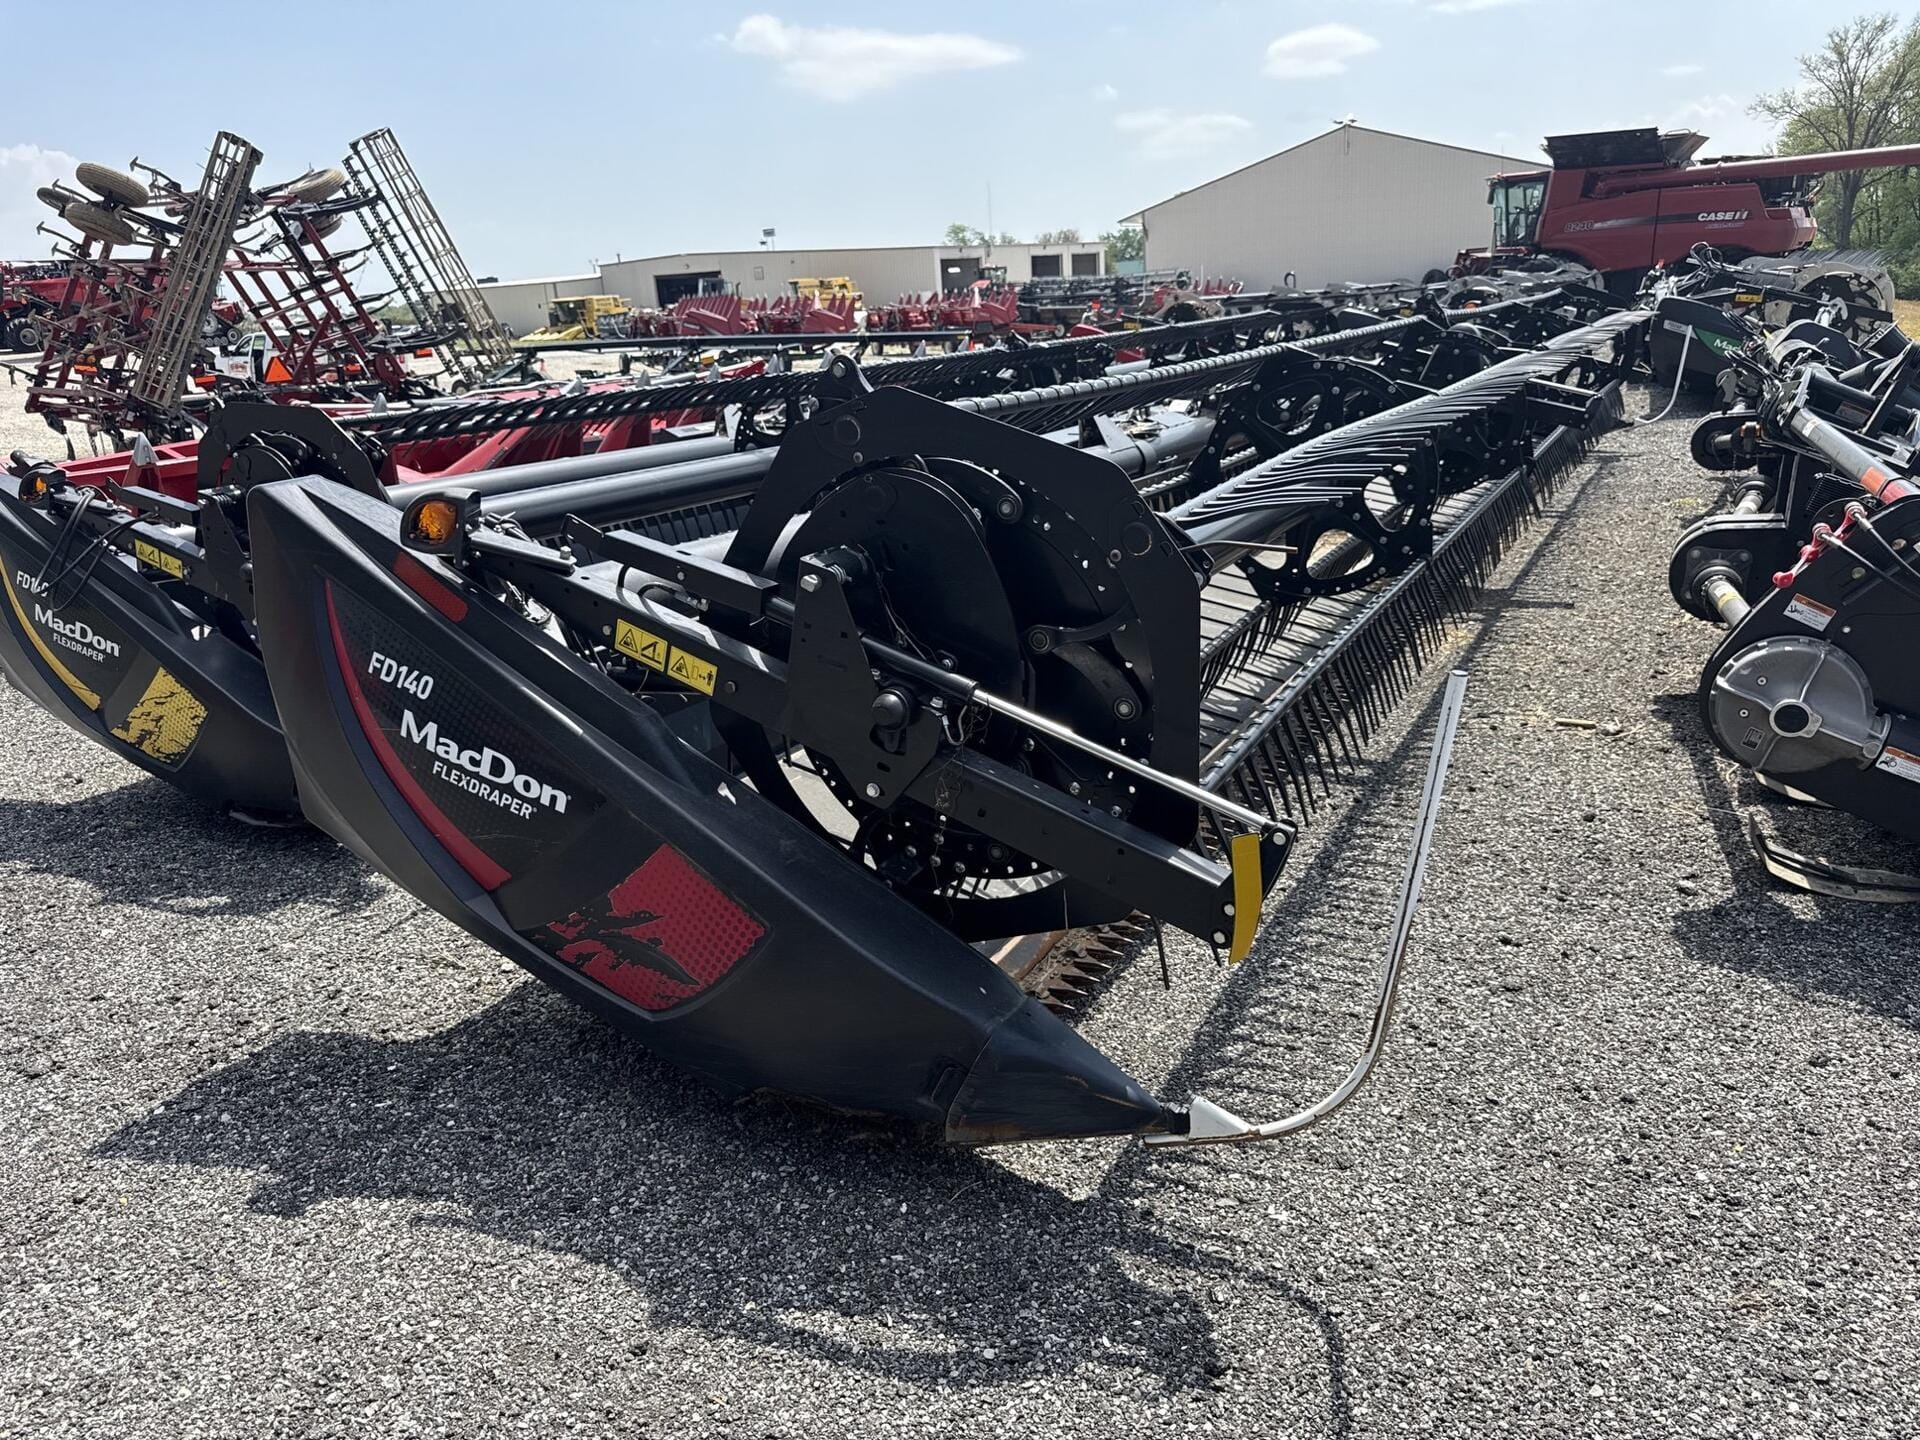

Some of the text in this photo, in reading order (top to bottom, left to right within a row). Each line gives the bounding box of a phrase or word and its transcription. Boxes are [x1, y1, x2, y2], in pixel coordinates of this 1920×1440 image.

[1697, 211, 1735, 222] CASE
[34, 603, 120, 657] MacDon
[53, 633, 105, 663] FLEXDRAPER
[367, 651, 434, 700] FD140
[400, 709, 569, 814] MacDon
[432, 761, 534, 819] FLEXDRAPER
